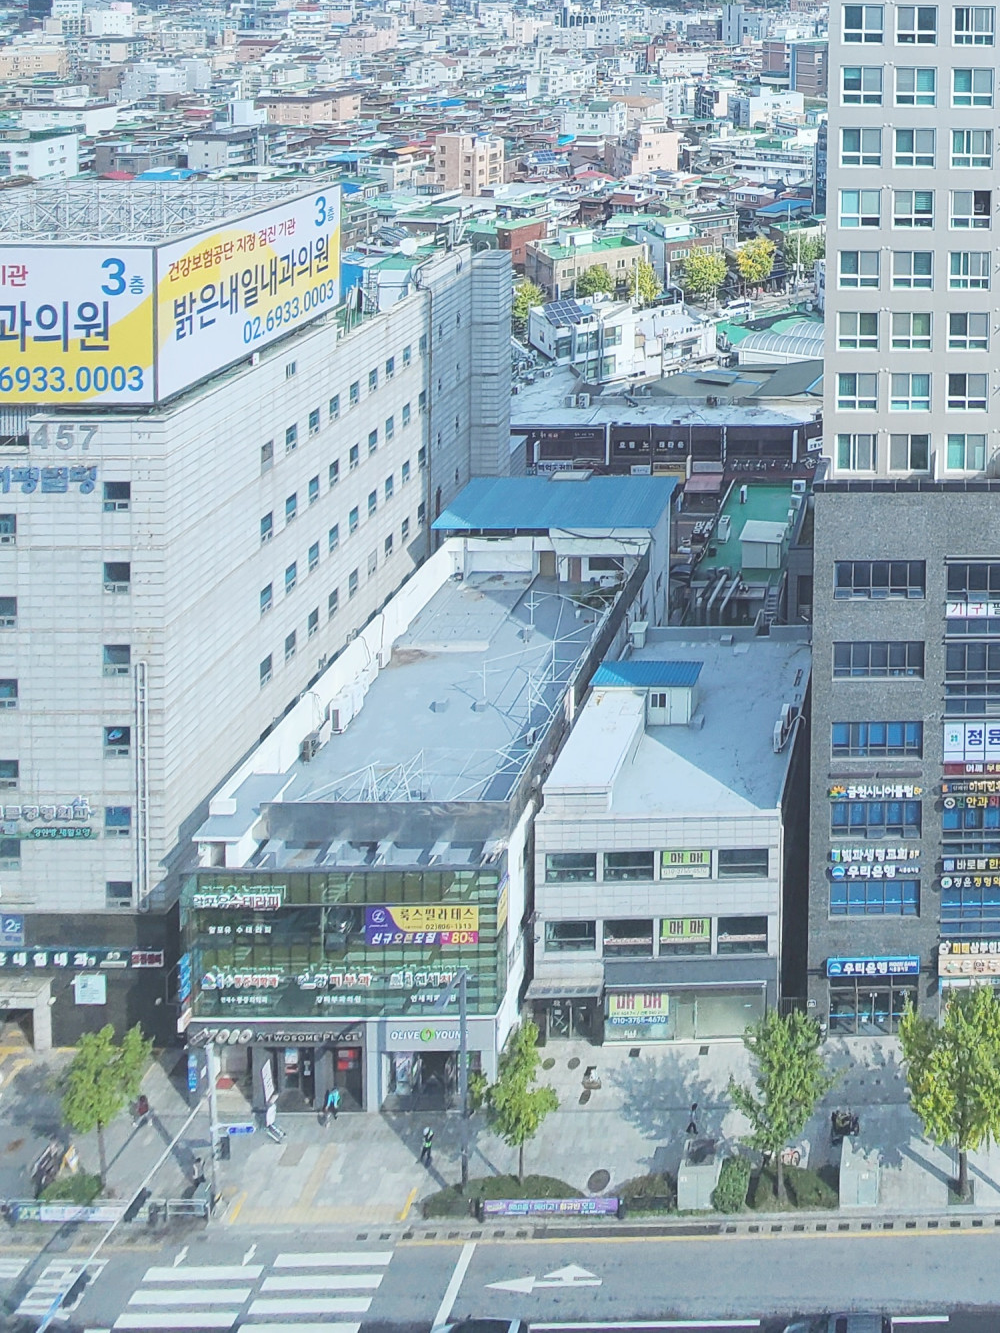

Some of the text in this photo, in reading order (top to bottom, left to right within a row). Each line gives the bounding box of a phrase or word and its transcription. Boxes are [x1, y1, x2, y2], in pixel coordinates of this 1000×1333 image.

[314, 196, 335, 227] 3층
[168, 217, 296, 283] 건강보험공단 지정 검진 기관
[101, 257, 145, 296] 3층
[173, 233, 330, 342] 밝은내일내과의원
[243, 278, 335, 345] 02.6933.0003
[31, 424, 98, 450] 457
[846, 865, 895, 879] 우리은행
[842, 961, 888, 976] 우리은행
[264, 1032, 320, 1042] TWOSOME
[322, 1031, 360, 1042] PLACE
[390, 1029, 469, 1040] OLIVE YOUN
